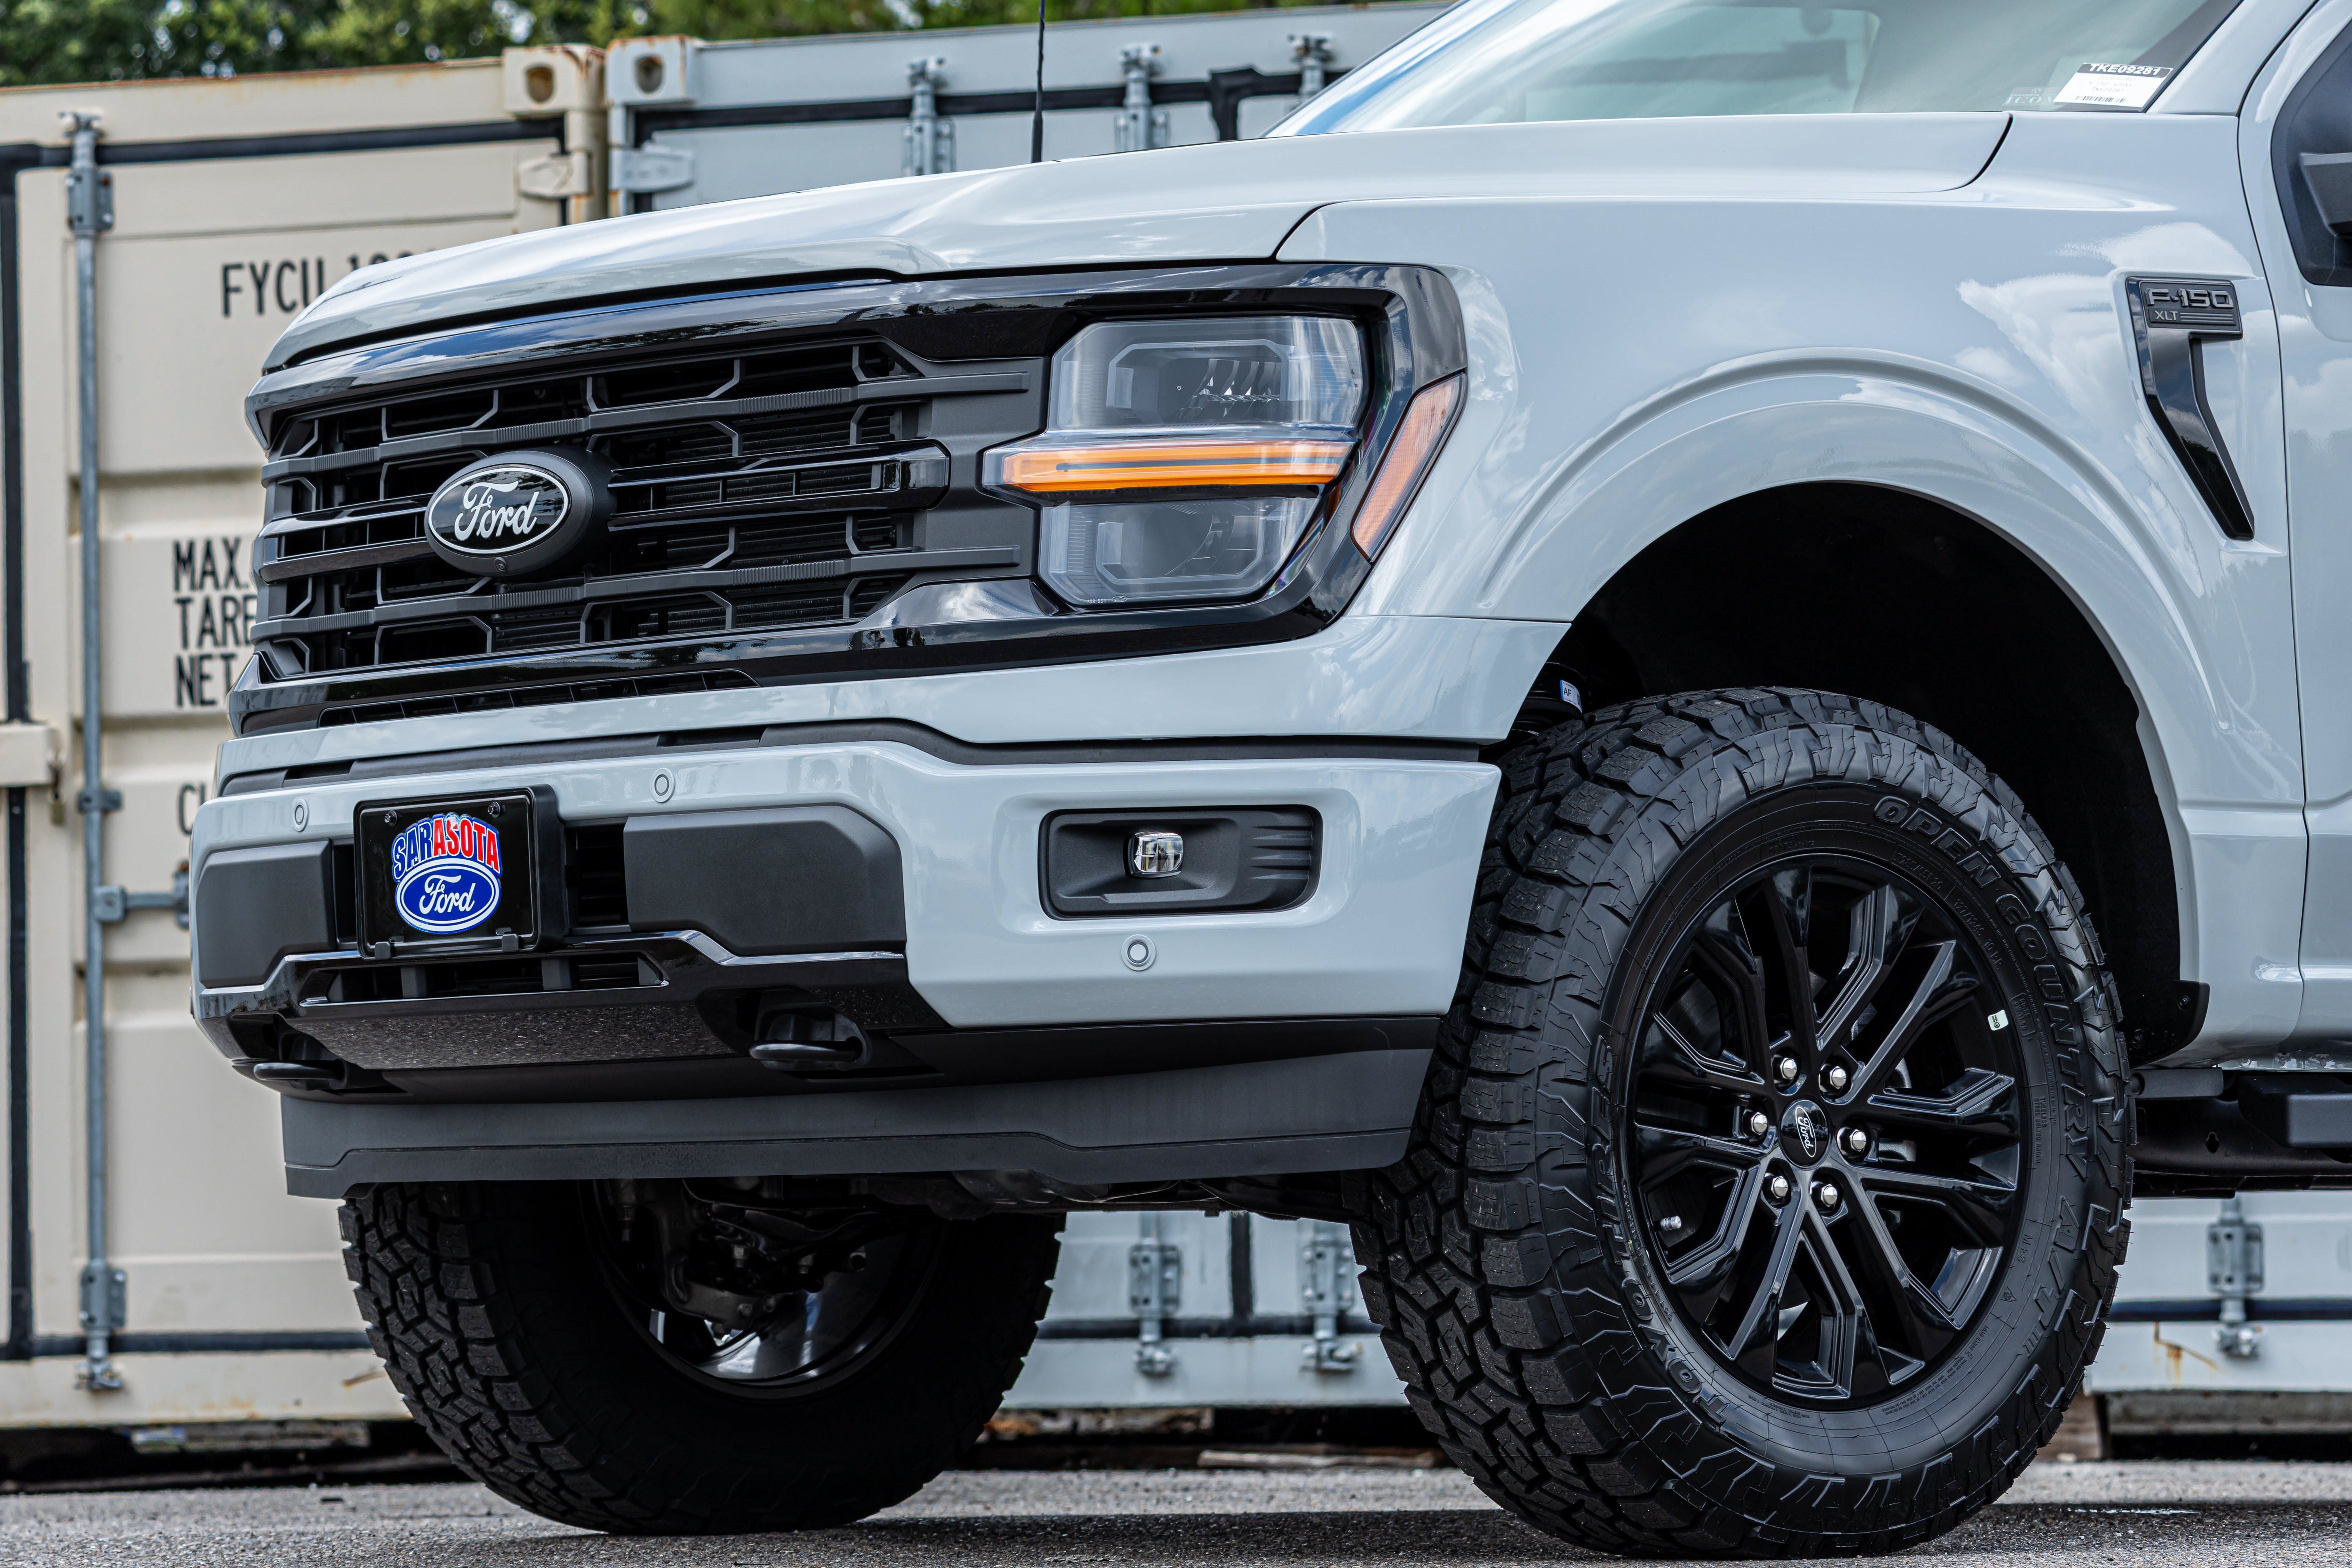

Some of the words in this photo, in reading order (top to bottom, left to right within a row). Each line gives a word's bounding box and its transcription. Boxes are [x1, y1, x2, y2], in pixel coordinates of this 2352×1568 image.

[2089, 64, 2161, 76] TKE09281
[221, 257, 327, 317] FYCU
[2145, 287, 2234, 309] F-150
[2154, 310, 2178, 321] XLT
[454, 480, 540, 541] Ford
[173, 536, 249, 592] MAX.
[174, 593, 257, 650] TARE
[174, 653, 237, 707] NET
[1564, 687, 1572, 697] AF
[393, 815, 501, 880] SARASOTA
[419, 875, 476, 915] Ford
[1874, 795, 2002, 889] OPEN
[1995, 893, 2089, 1180] COUNTRY
[1797, 1116, 1814, 1149] Ford
[1621, 1278, 1728, 1426] TOYO
